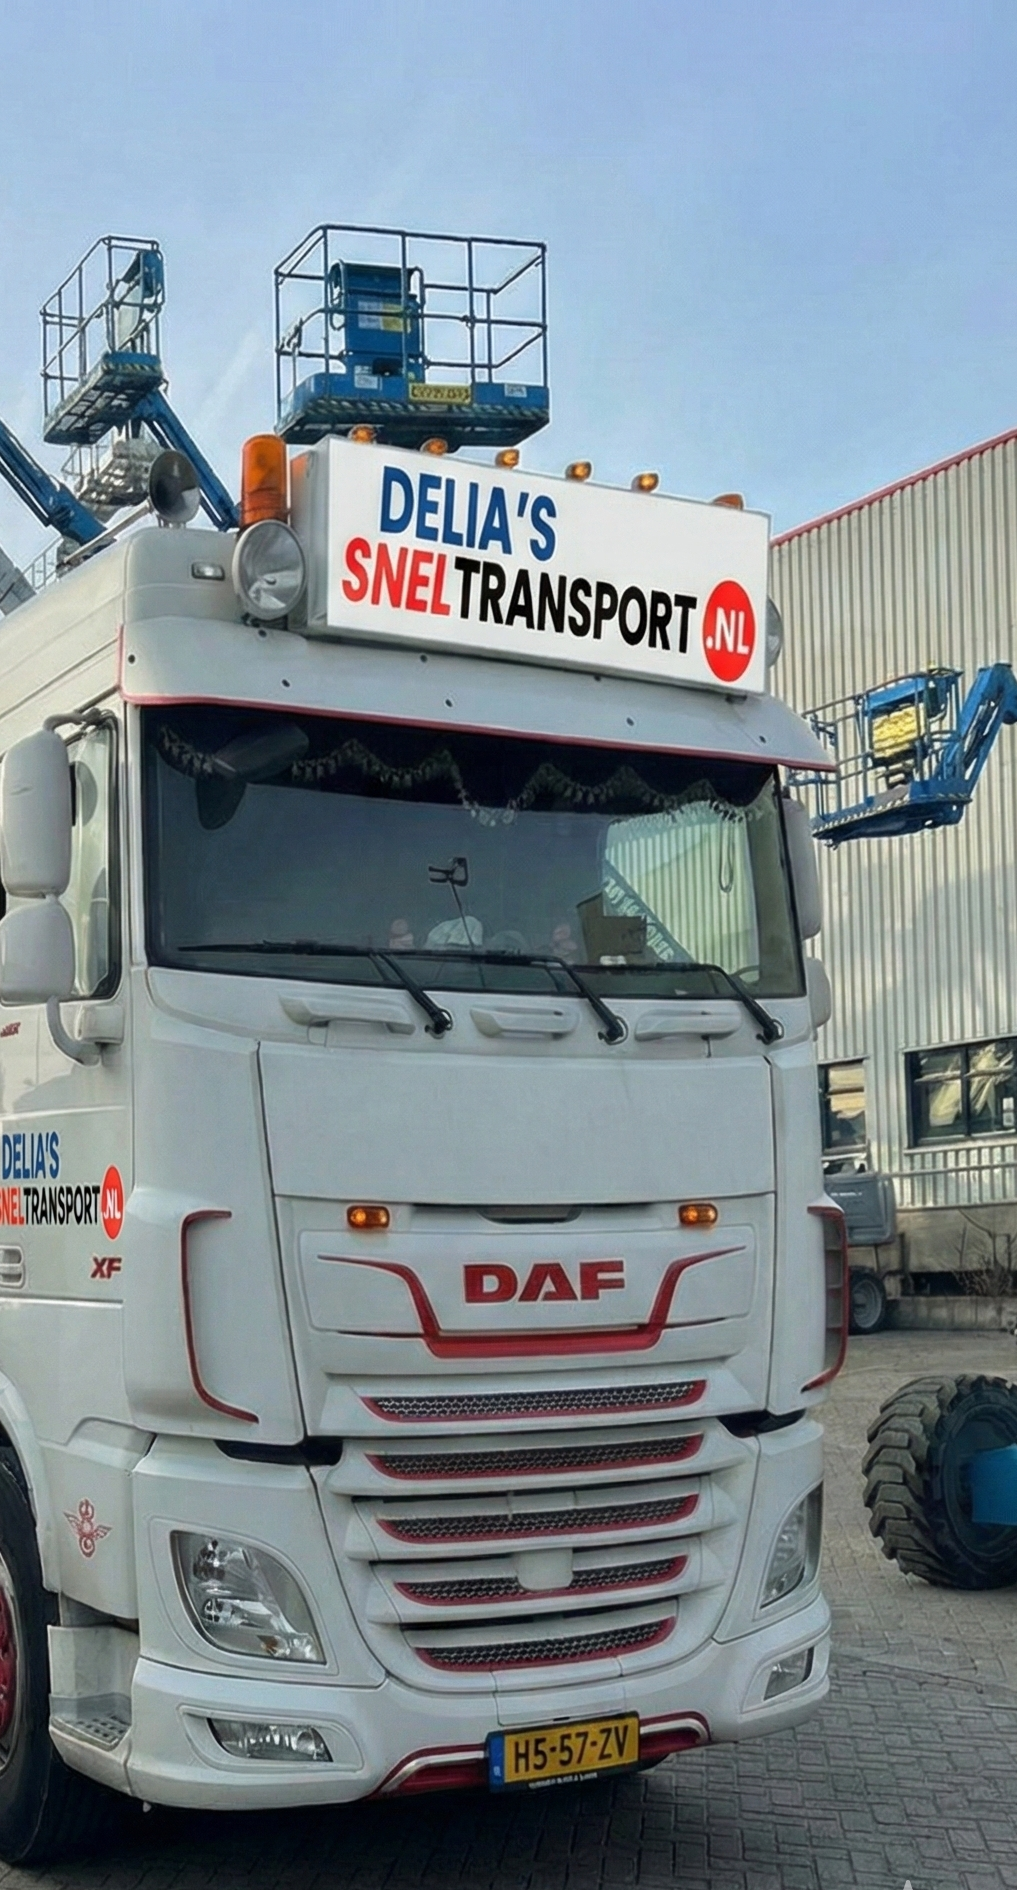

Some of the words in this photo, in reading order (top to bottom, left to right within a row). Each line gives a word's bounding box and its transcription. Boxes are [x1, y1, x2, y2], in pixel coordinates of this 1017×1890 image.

[380, 466, 557, 561] DELIA'S
[1, 1131, 60, 1180] DELIA'S
[90, 1256, 122, 1280] XF
[463, 1259, 626, 1304] DAF
